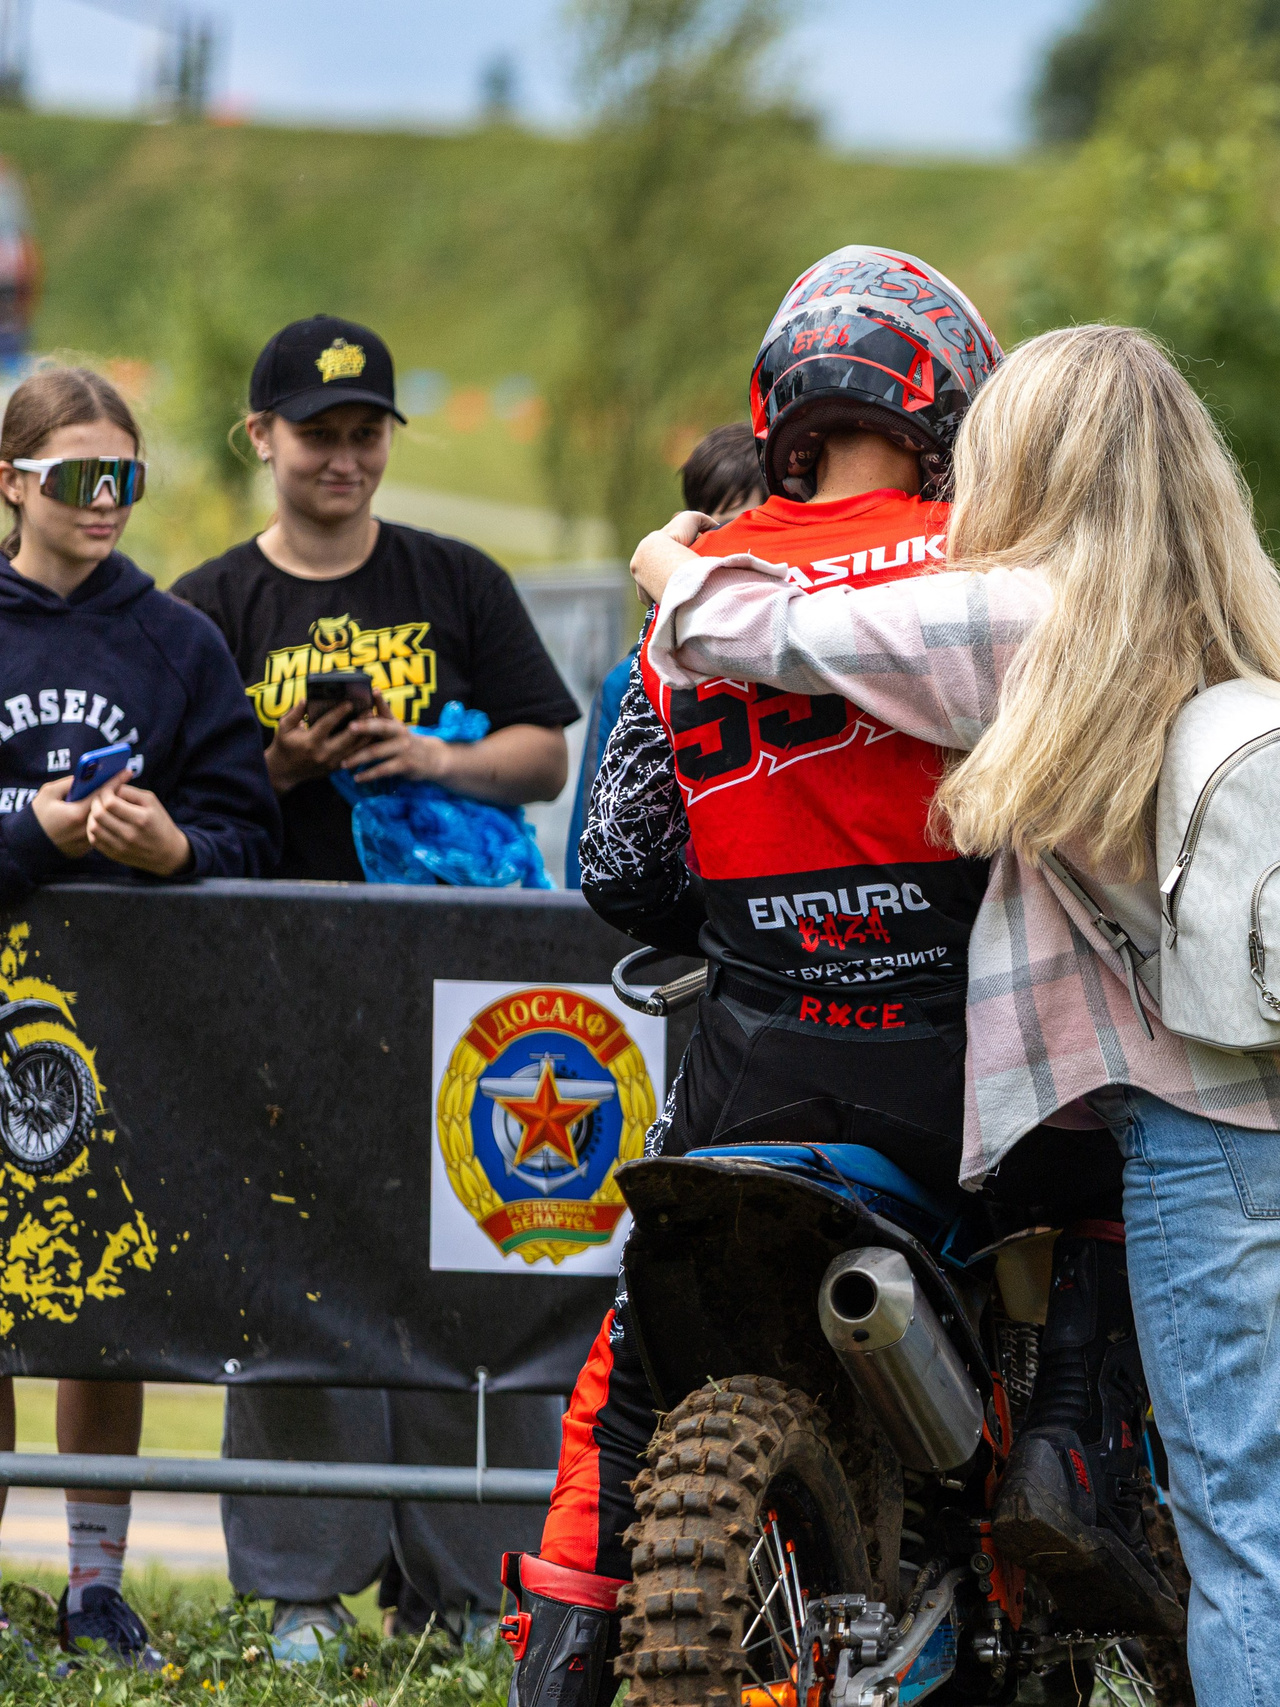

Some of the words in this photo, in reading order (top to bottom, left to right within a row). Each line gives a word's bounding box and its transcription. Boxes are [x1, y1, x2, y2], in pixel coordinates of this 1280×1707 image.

[792, 323, 851, 355] EF56
[262, 654, 426, 718] UAN
[0, 688, 139, 745] RSEIL
[47, 748, 71, 773] LE
[748, 882, 931, 930] ENDURO
[796, 907, 891, 953] BAZA
[490, 994, 607, 1040] ДОСААФ
[511, 1212, 595, 1233] БЕЛАРУСЬ
